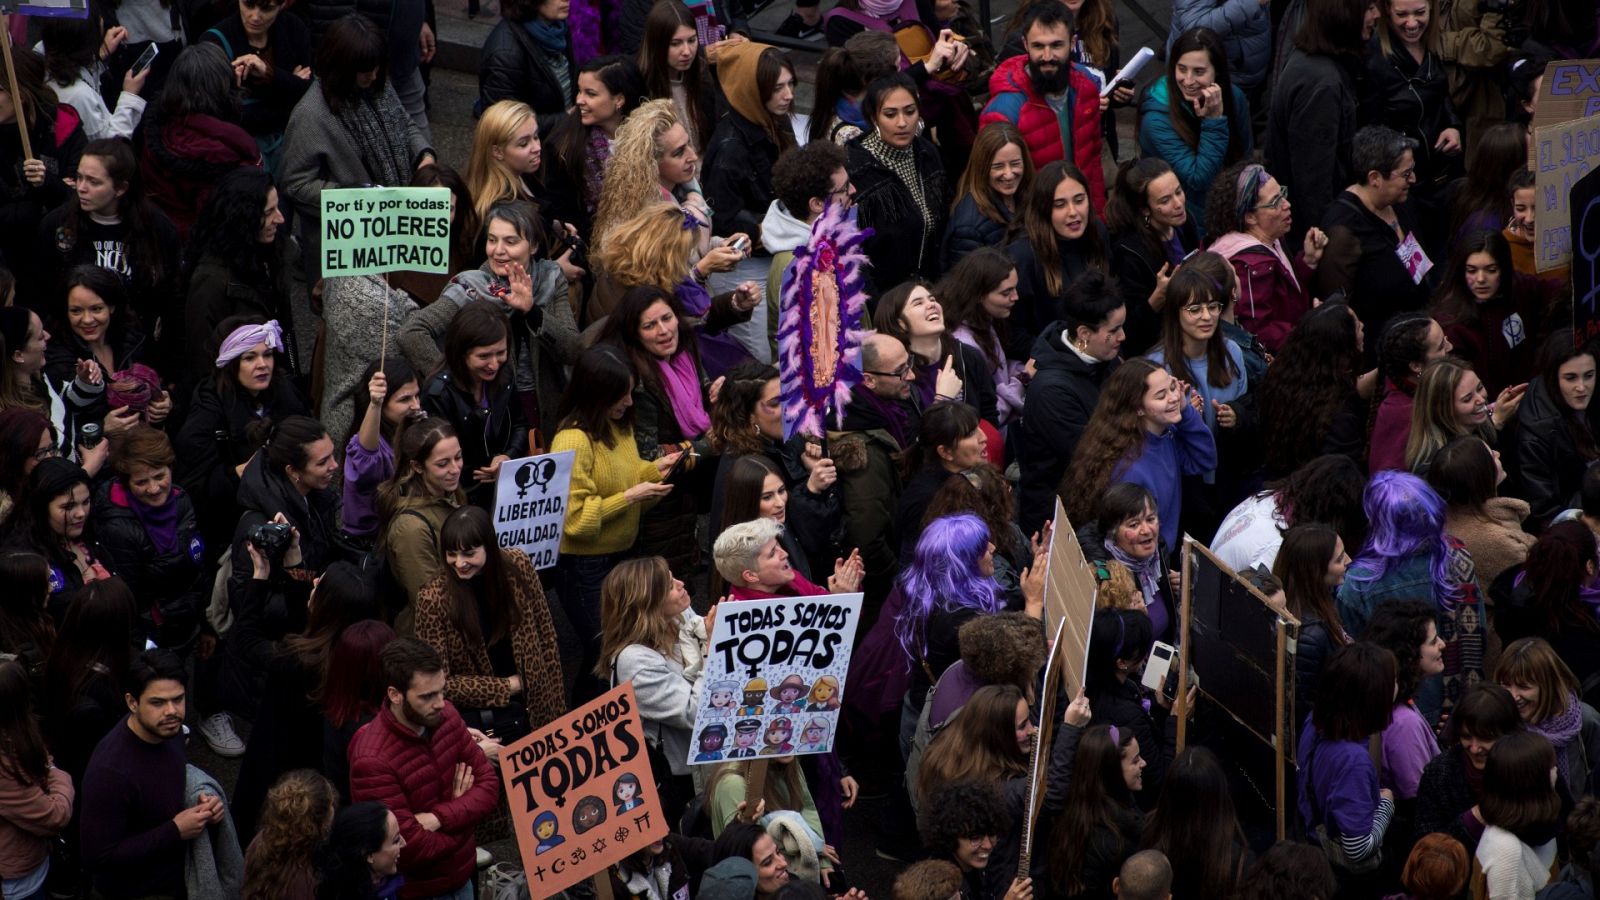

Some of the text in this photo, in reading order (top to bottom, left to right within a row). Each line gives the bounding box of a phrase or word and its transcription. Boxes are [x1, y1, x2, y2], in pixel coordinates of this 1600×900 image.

[326, 201, 350, 212] Por
[366, 201, 375, 213] y
[379, 199, 402, 212] por
[406, 198, 449, 210] todas:
[327, 216, 448, 240] NO TOLERES
[327, 244, 447, 270] EL MALTRATO.
[498, 496, 564, 522] LIBERTAD,
[528, 549, 555, 568] TAD.
[725, 603, 851, 636] TODAS SOMOS
[716, 629, 842, 678] TODAS
[506, 694, 630, 773] TODAS SOMOS
[511, 720, 640, 813] TODAS
